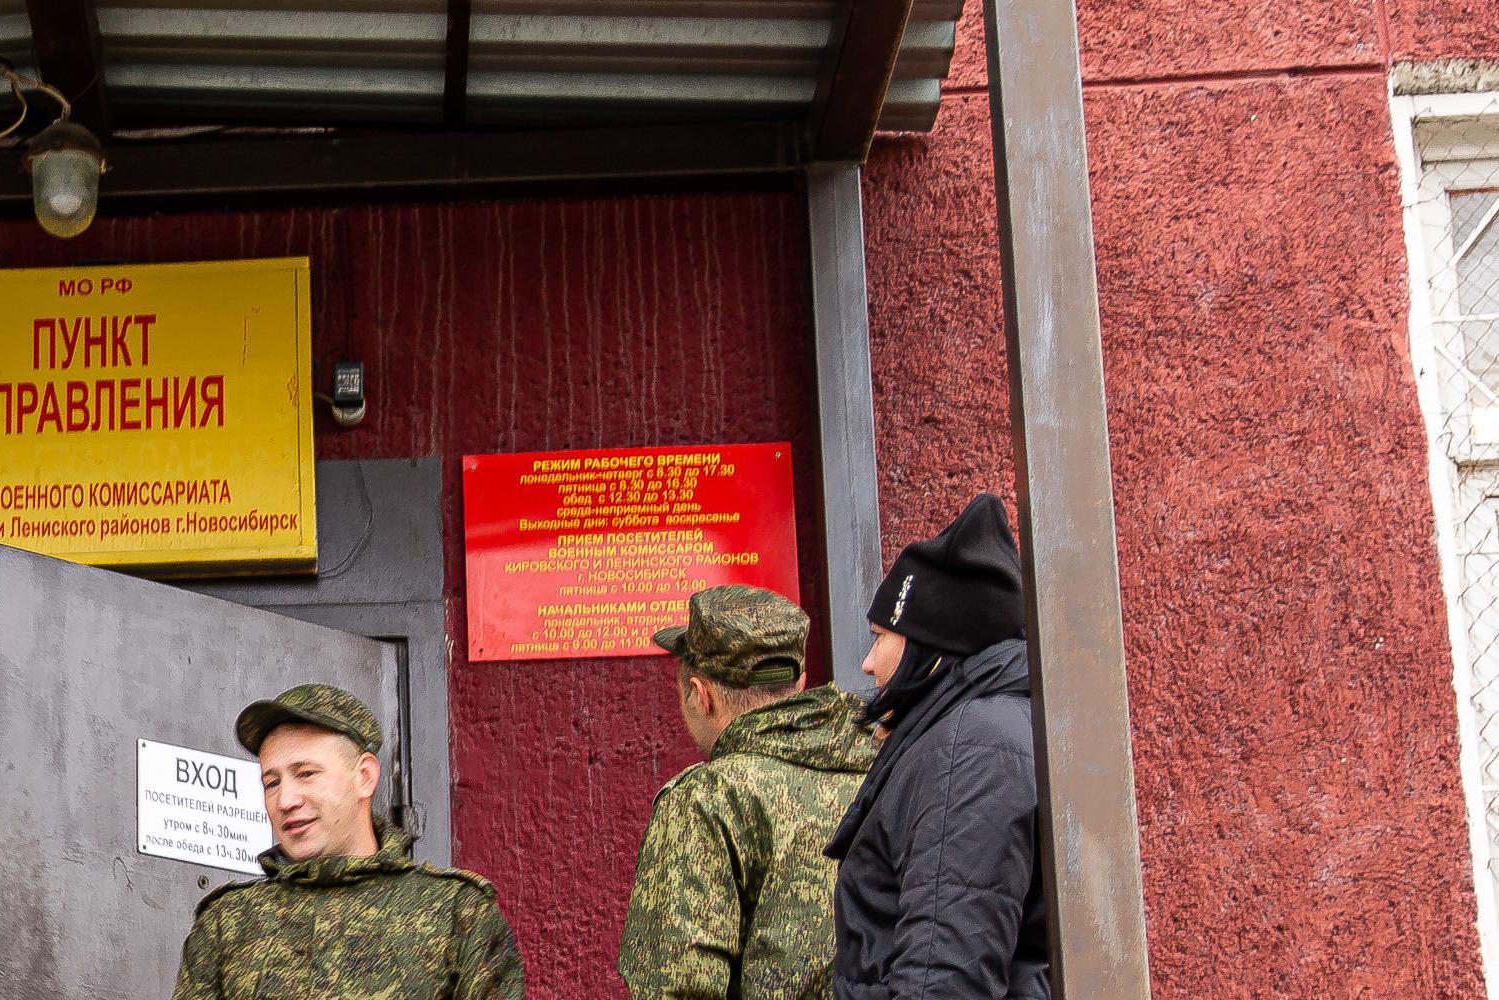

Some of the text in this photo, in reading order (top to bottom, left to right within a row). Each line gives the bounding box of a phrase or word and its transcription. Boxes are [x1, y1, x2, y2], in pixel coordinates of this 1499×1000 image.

[58, 277, 132, 297] МО РФ
[32, 314, 156, 370] ПУНКТ
[533, 453, 721, 472] РЕЖИМ РАБОЧЕГО ВРЕМЕНИ
[646, 469, 654, 480] с
[656, 466, 682, 479] 8.30
[684, 468, 699, 481] до
[704, 464, 735, 477] 17.30
[90, 479, 232, 507] КОМИССАРИАТА
[558, 477, 698, 494] пятница с 8.30 до 16.30
[563, 489, 694, 506] обед с 12.30 до 13.30
[672, 503, 701, 514] день
[10, 516, 96, 539] Лениского
[100, 512, 171, 539] районов
[519, 519, 580, 531] Выходные
[611, 514, 659, 529] суббота
[666, 512, 740, 526] воскресенье
[557, 528, 703, 546] ПРИЕМ ПОСЕТИТЕЛЕЙ
[548, 542, 714, 559] ВОЕННЫМ КОМИССАРОМ
[504, 559, 590, 573] КИРОВСКОГО
[593, 558, 602, 569] И
[606, 554, 693, 569] ЛЕНИНСКОГО
[588, 568, 687, 582] НОВОСИБИРСК
[559, 585, 607, 596] пятница
[610, 584, 617, 593] с
[621, 581, 653, 593] 10.00
[655, 582, 671, 593] до
[537, 602, 646, 617] НАЧАЛЬНИКАМИ
[532, 631, 539, 641] с
[577, 629, 593, 640] до
[631, 628, 638, 637] и
[641, 628, 648, 637] с
[511, 642, 560, 653] пятница
[562, 641, 569, 651] с
[601, 640, 616, 650] до
[176, 757, 238, 799] ВХОД
[145, 789, 215, 814] ПОСЕТИТЕЛЕЙ
[163, 818, 192, 831] утром
[194, 824, 200, 833] с
[146, 834, 174, 848] после
[176, 838, 204, 854] обеда
[206, 846, 212, 855] с
